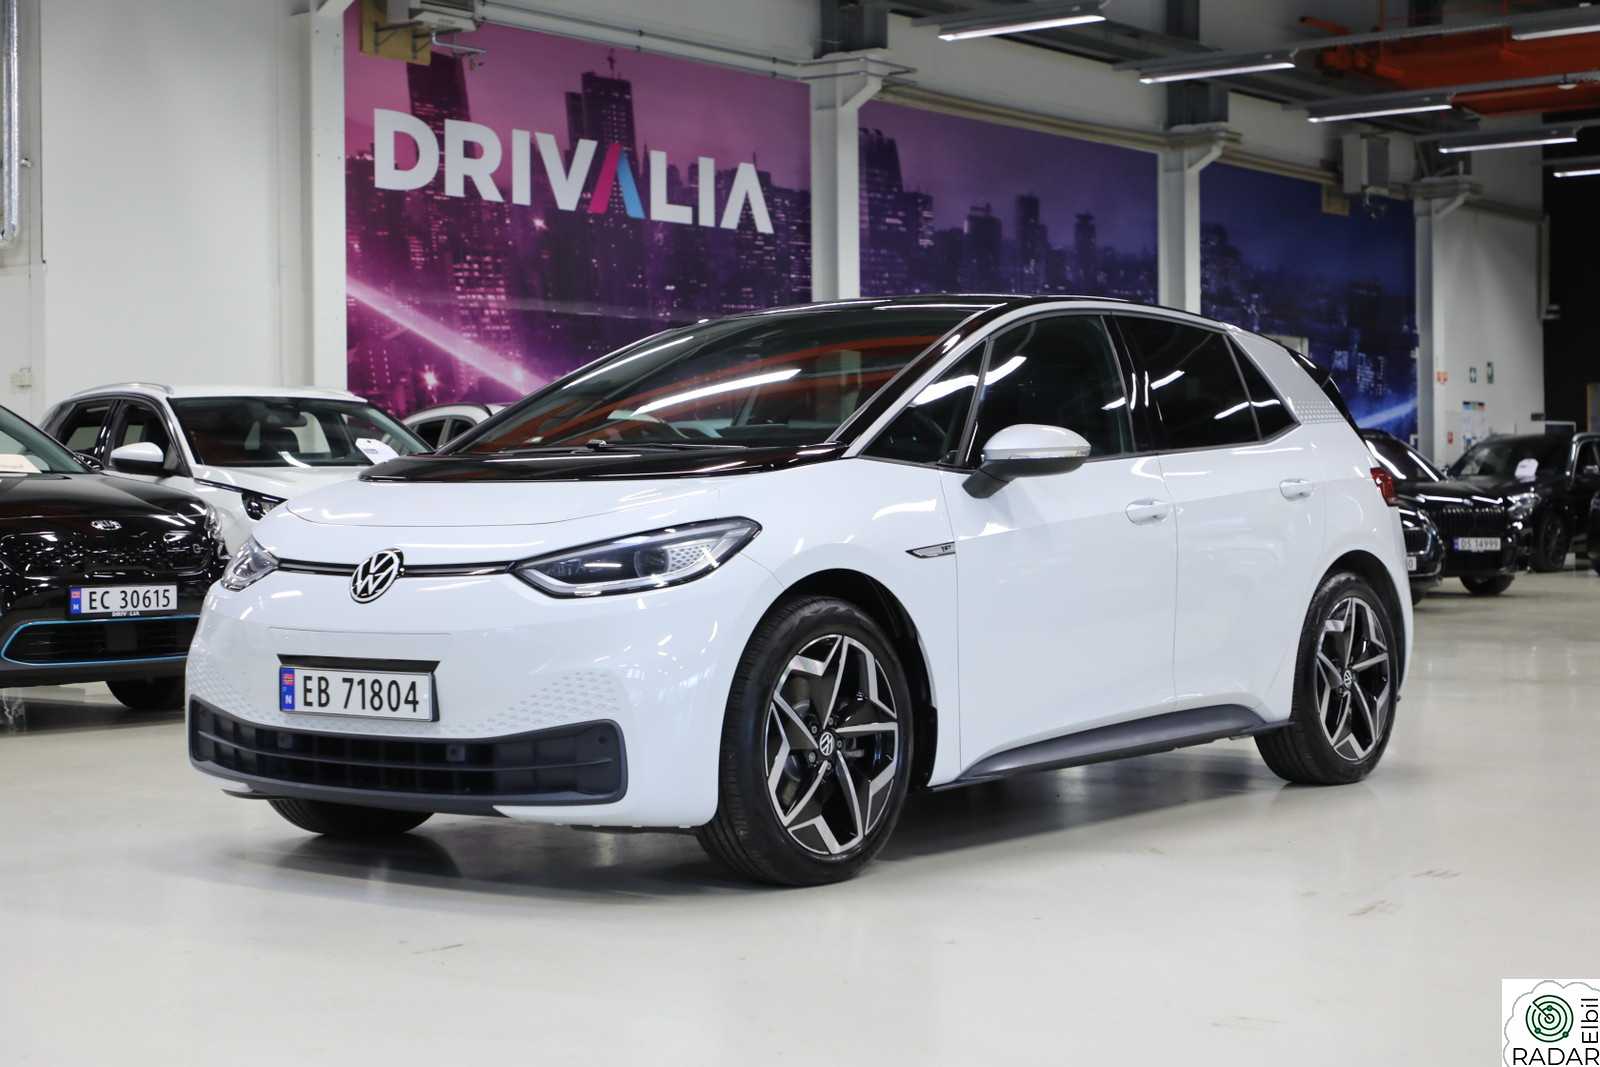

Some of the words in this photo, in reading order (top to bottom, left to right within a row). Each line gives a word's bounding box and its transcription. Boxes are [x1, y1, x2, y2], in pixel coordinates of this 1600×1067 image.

[374, 108, 774, 234] DRIVALIA
[1475, 538, 1499, 549] 14999
[89, 590, 110, 610] EC
[119, 589, 170, 609] 30615
[303, 675, 330, 707] EB
[342, 677, 419, 713] 71804
